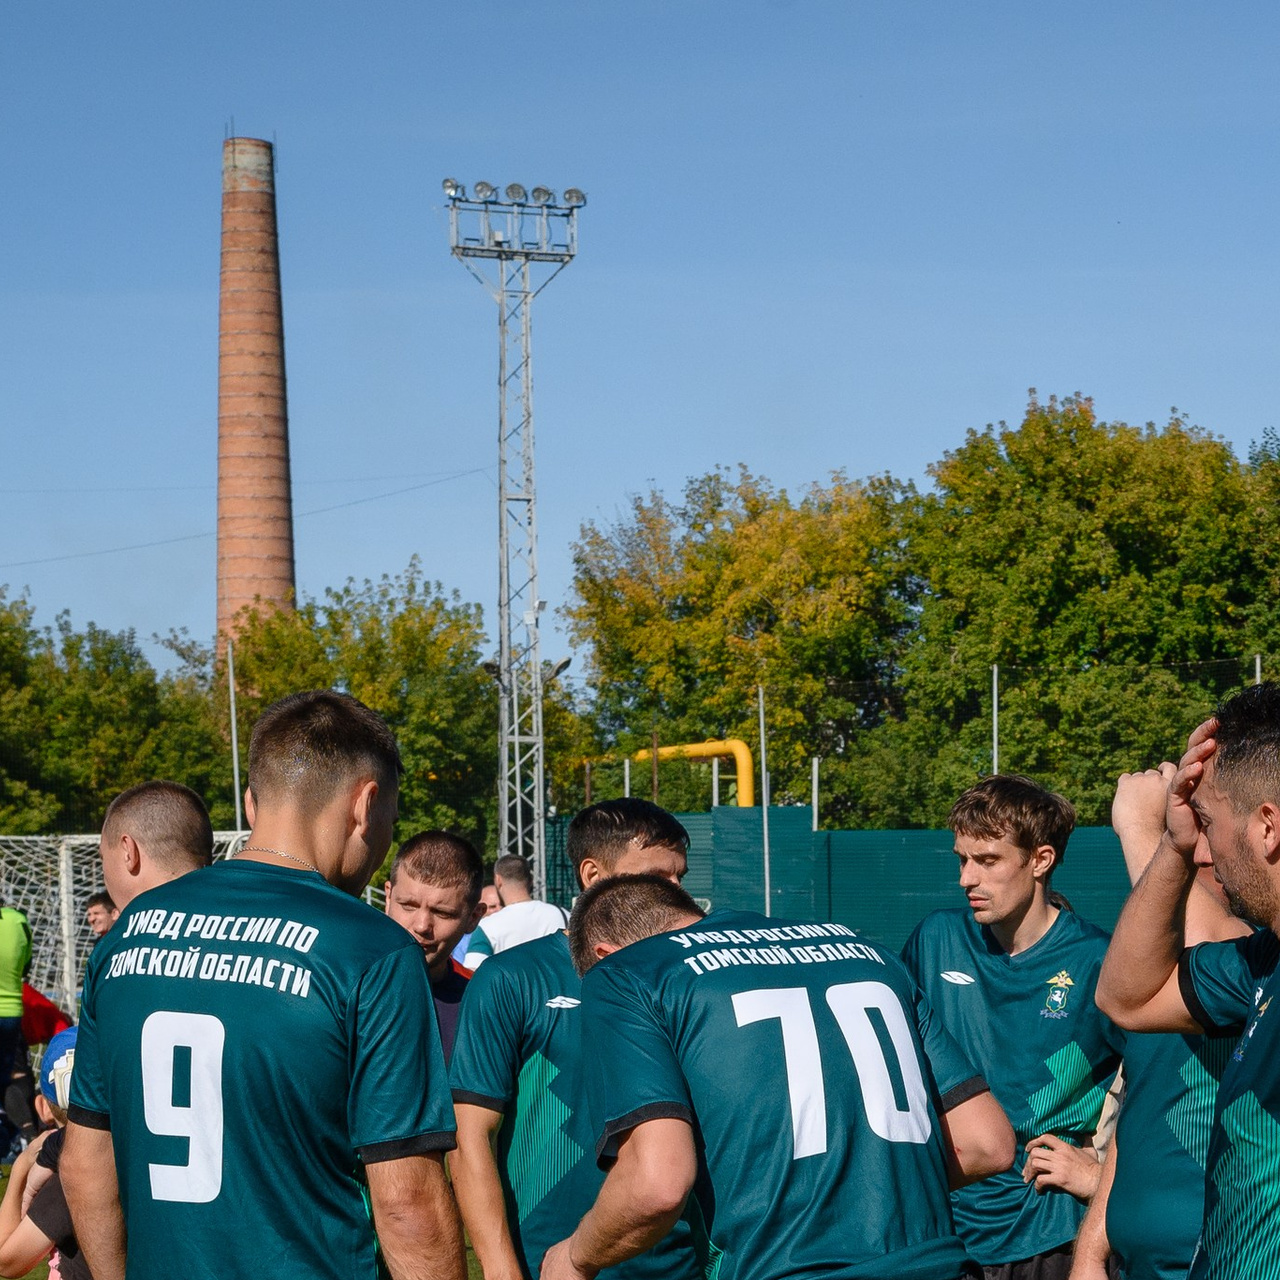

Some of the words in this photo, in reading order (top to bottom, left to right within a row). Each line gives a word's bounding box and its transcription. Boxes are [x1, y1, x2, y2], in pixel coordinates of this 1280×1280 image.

[123, 909, 186, 940] УМВД
[183, 913, 282, 943] РОССИИ
[276, 920, 319, 954] ПО
[669, 930, 747, 948] УМВД
[741, 923, 827, 943] РОССИИ
[105, 946, 201, 980] ТОМСКОЙ
[199, 953, 311, 998] ОБЛАСТИ
[684, 944, 794, 976] ТОМСКОЙ
[789, 943, 886, 966] ОБЛАСТИ
[731, 981, 931, 1160] 70
[141, 1010, 225, 1204] 9
